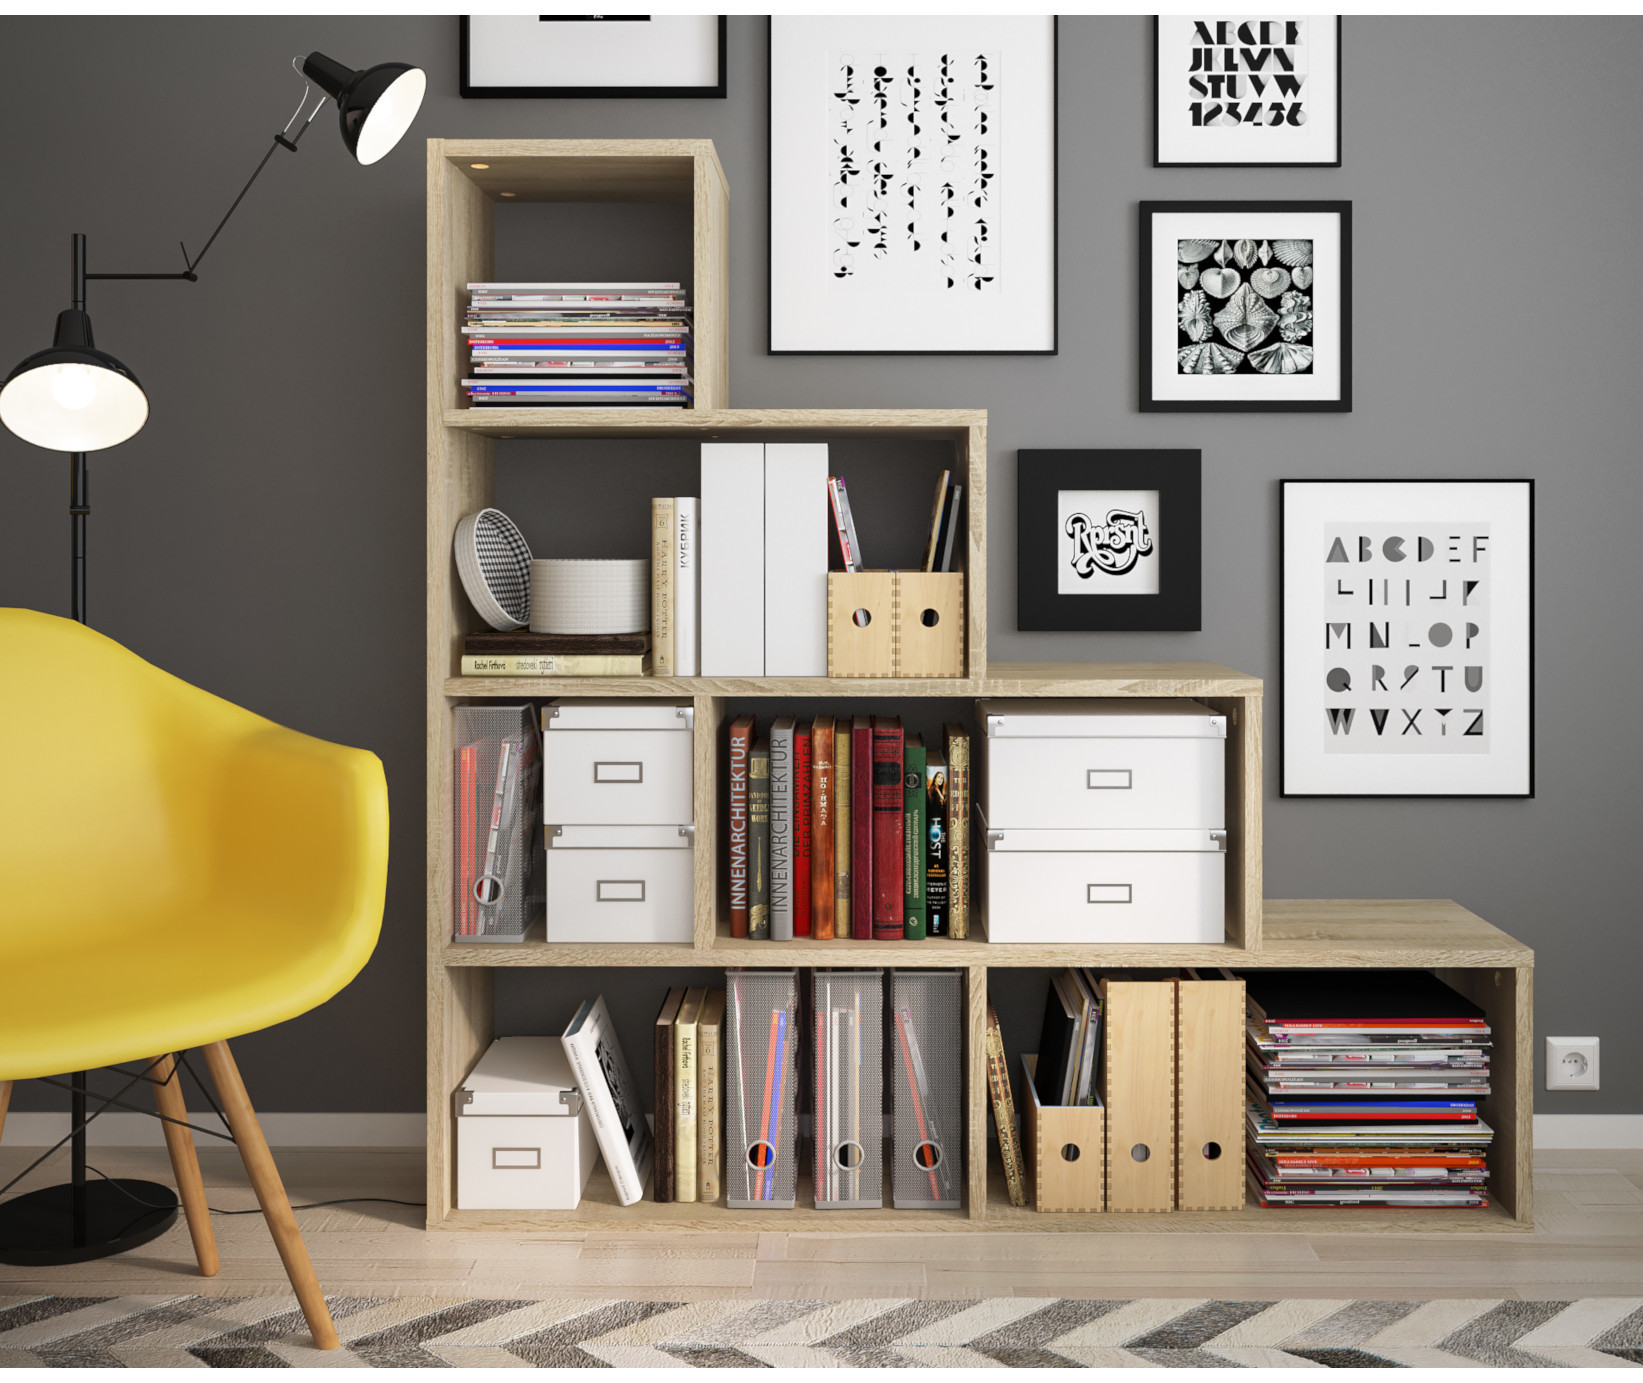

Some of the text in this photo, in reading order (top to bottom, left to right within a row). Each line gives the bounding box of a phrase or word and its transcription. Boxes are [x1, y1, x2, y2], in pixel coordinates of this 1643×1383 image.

[731, 736, 746, 909] INNENARCHITEKTUR
[772, 738, 788, 912] INNENARCHITEKTUR
[930, 817, 941, 859] HOST
